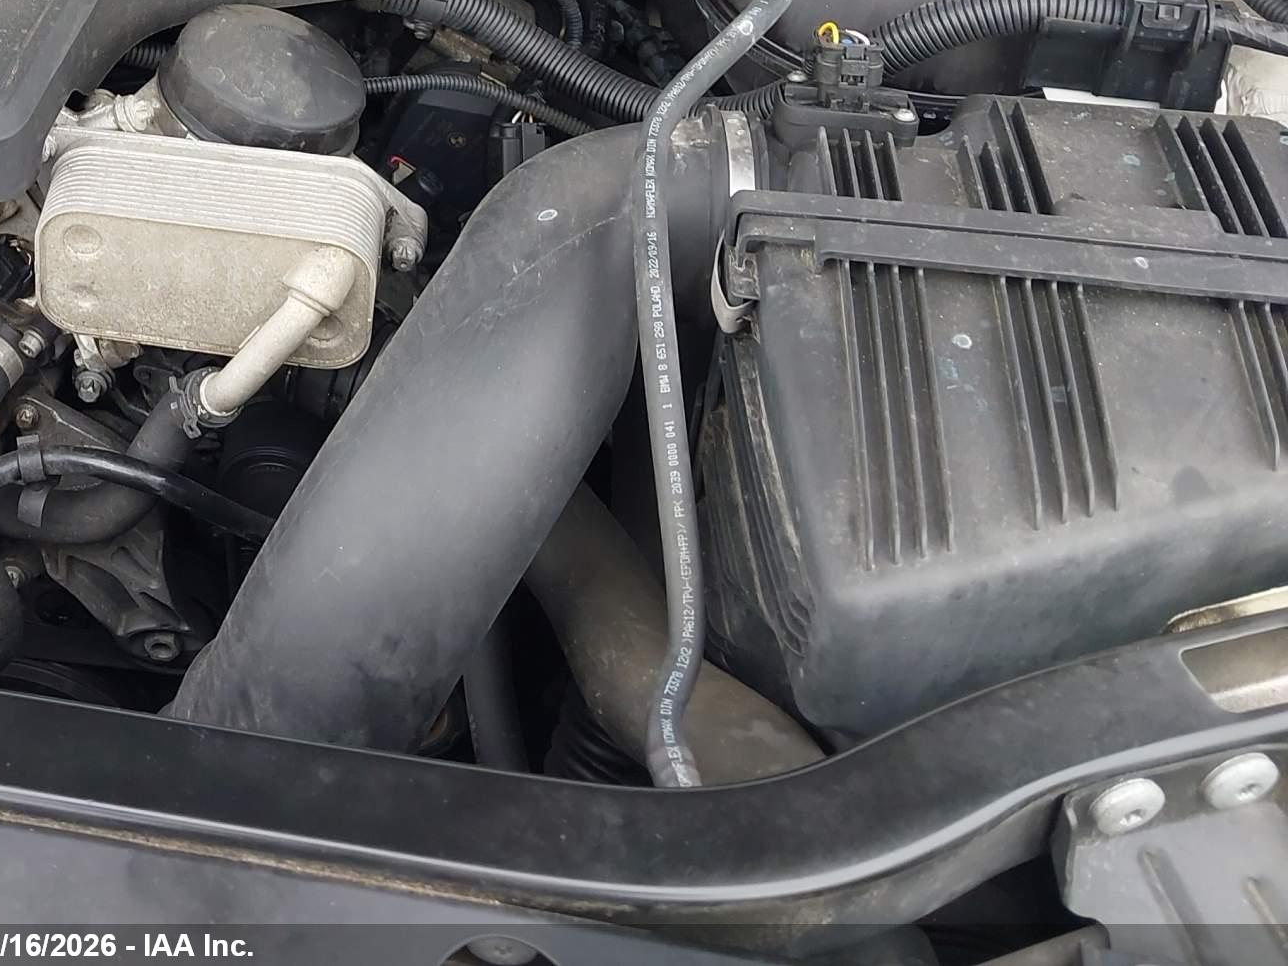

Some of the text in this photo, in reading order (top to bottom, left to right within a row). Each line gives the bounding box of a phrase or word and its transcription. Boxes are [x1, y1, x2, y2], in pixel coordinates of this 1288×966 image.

[646, 138, 657, 153] DIN
[647, 231, 660, 279] 2022/09/16
[651, 285, 663, 318] POLAND
[655, 343, 667, 360] 651
[658, 374, 671, 394] BMW
[664, 420, 676, 438] 041
[670, 470, 682, 494] 2039
[660, 698, 672, 715] DIN
